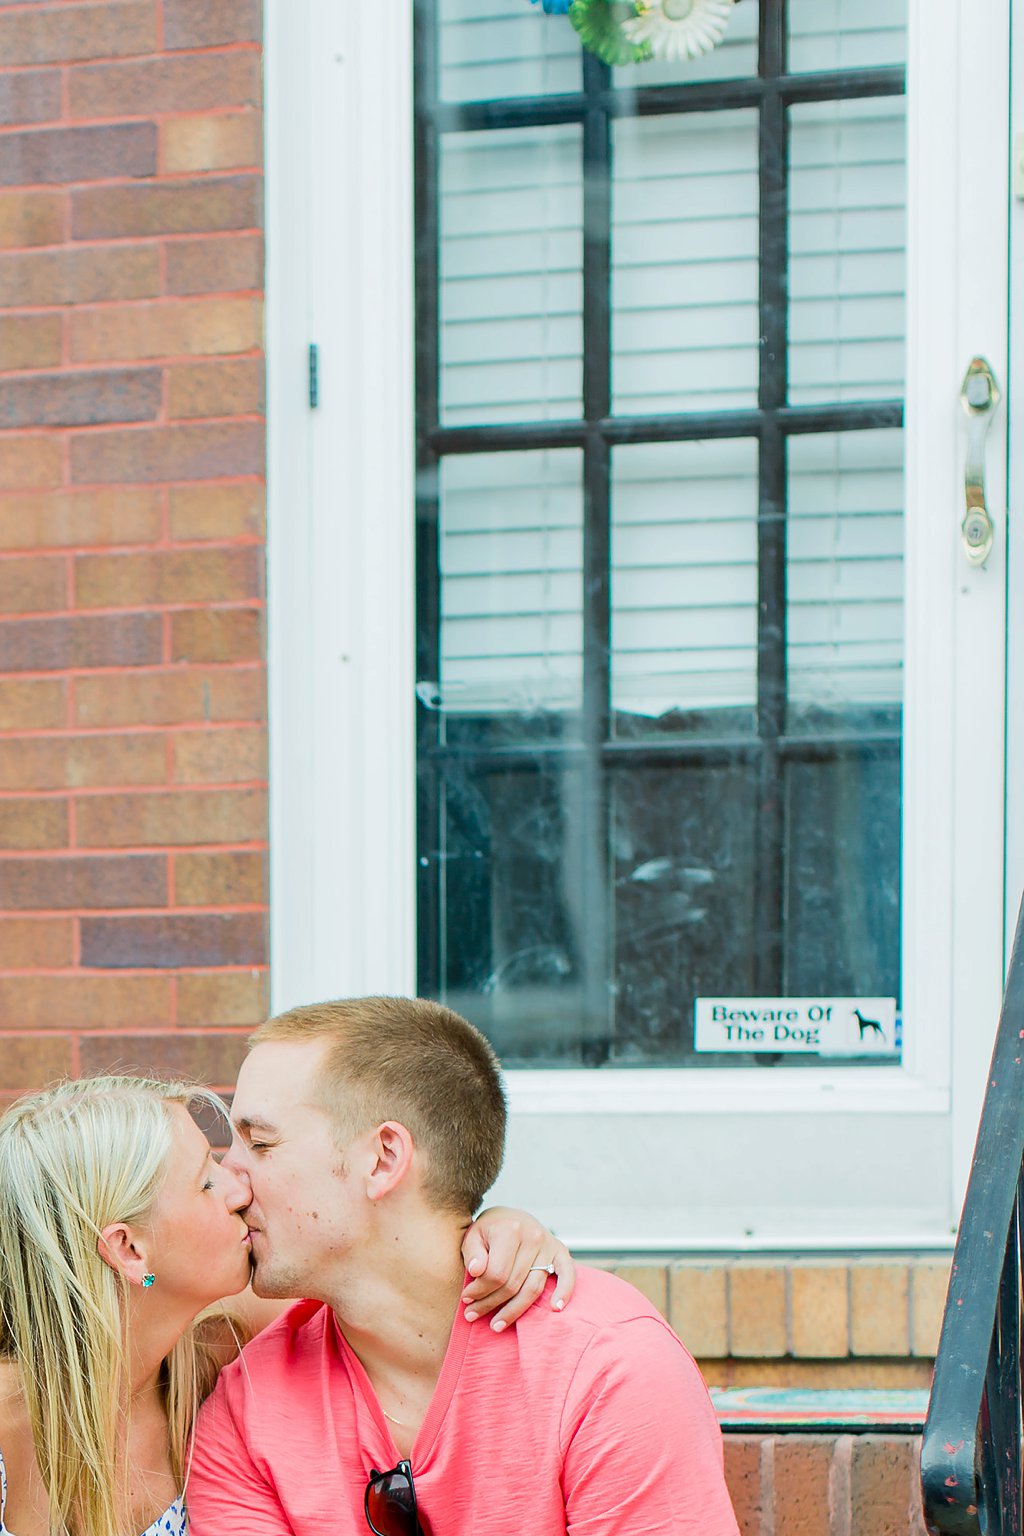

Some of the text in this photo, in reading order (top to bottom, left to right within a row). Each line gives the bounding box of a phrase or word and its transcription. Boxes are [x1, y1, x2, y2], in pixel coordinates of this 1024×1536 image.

[712, 1005, 832, 1021] Beware Of
[725, 1024, 820, 1044] The Dog
